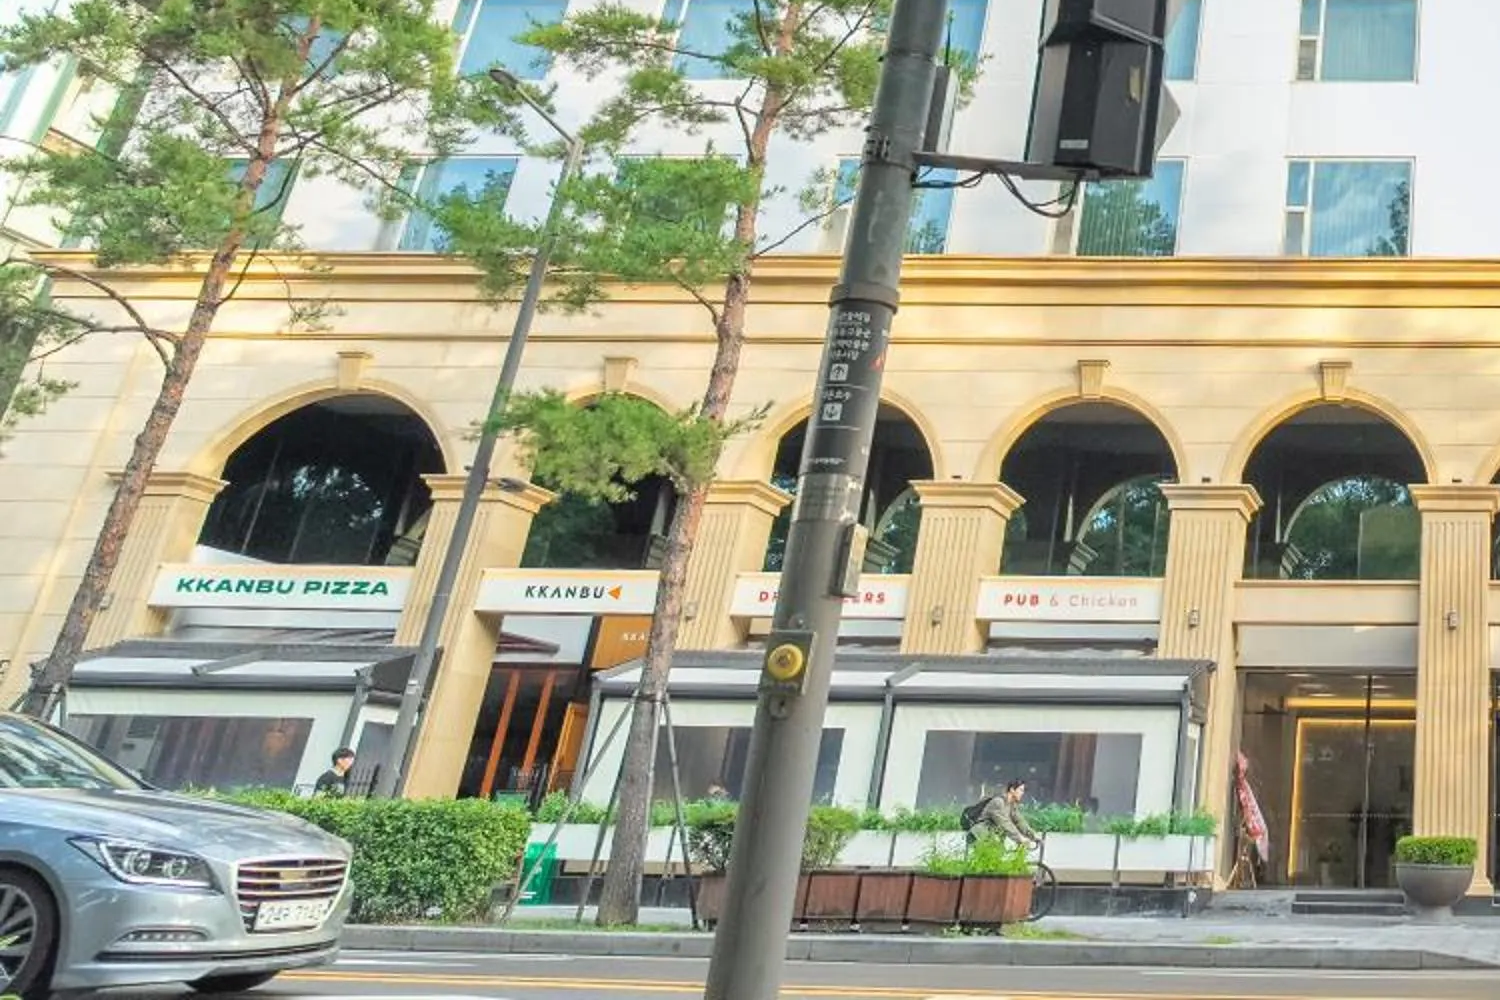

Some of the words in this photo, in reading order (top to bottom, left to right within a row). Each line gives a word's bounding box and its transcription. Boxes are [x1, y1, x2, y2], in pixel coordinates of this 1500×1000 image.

[176, 577, 295, 594] KKANBU
[303, 580, 389, 596] PIZZA
[524, 585, 605, 599] KKANBU
[1003, 593, 1040, 607] PUB
